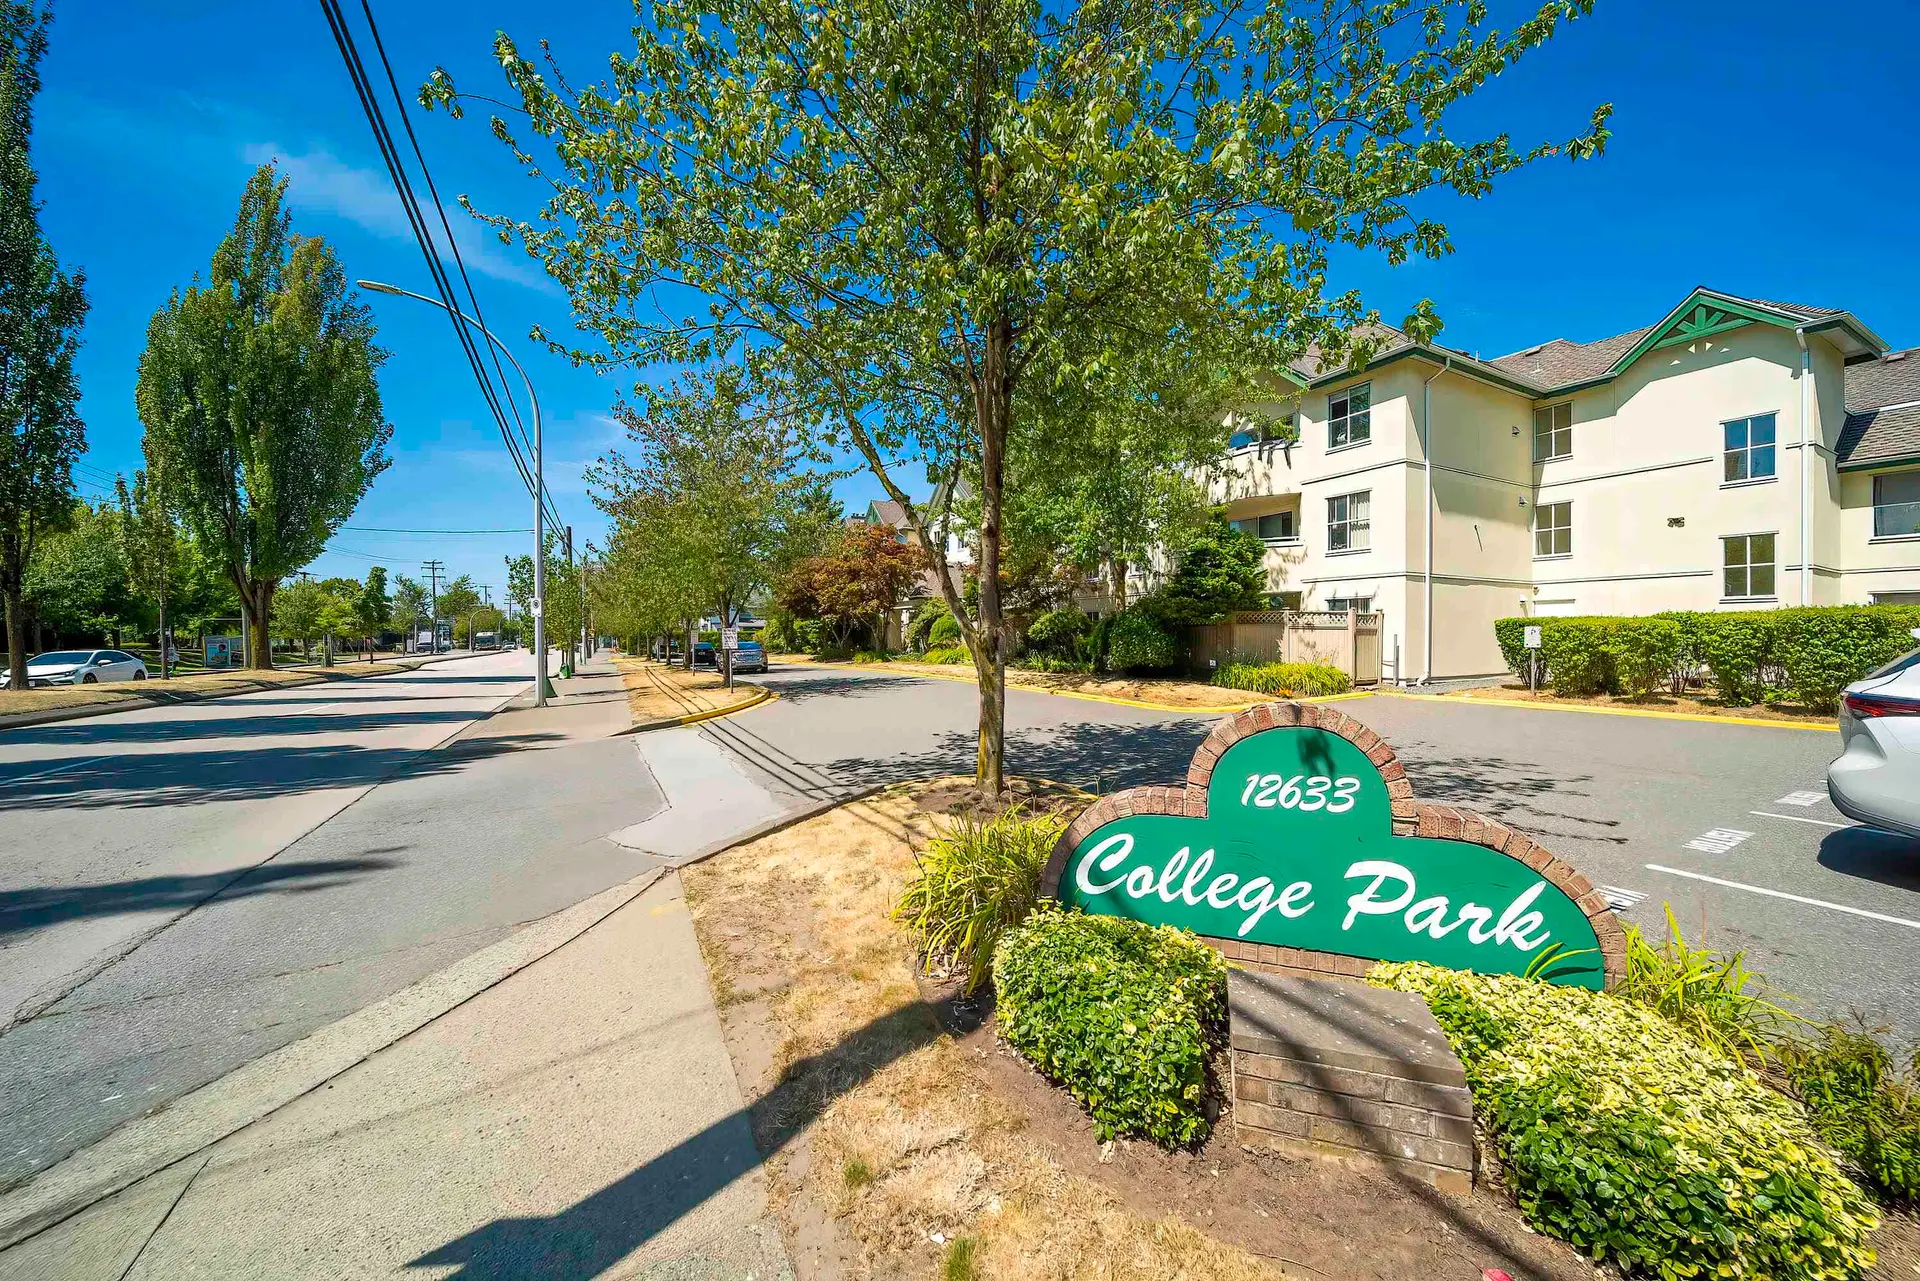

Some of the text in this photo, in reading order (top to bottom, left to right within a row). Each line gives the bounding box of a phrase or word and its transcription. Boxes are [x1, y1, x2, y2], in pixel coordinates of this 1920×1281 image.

[1241, 773, 1360, 813] 12633
[1075, 833, 1551, 952] College Park
